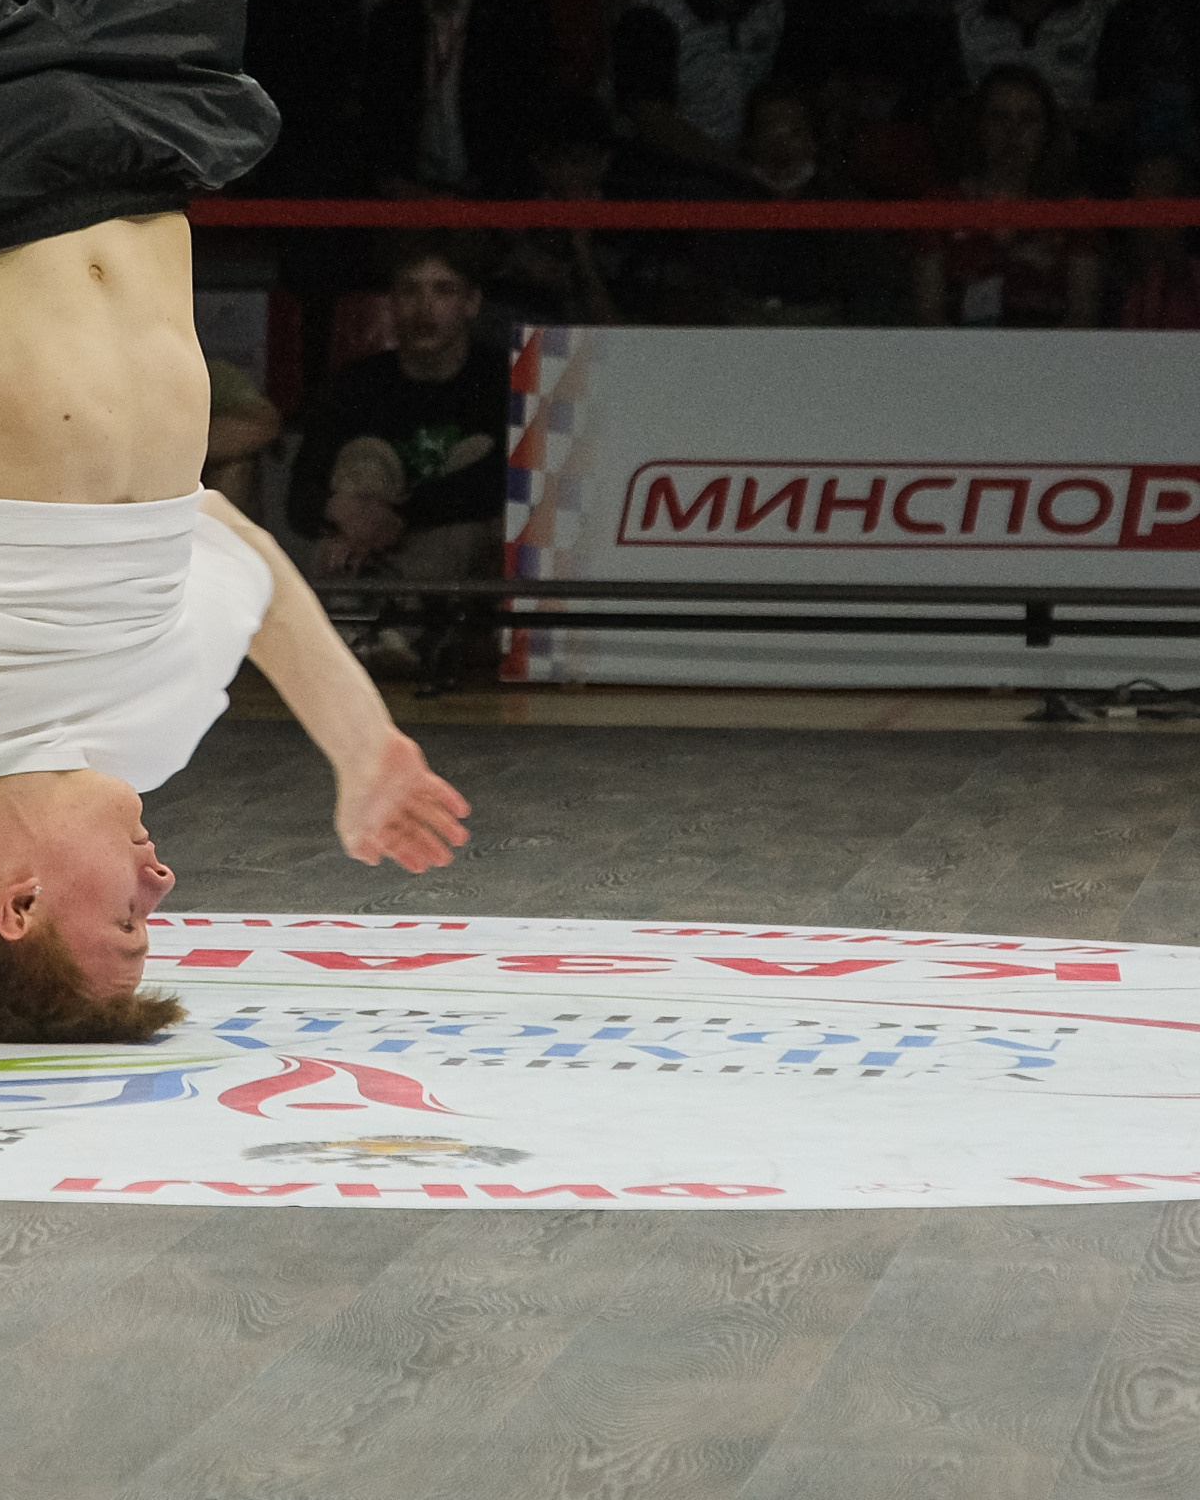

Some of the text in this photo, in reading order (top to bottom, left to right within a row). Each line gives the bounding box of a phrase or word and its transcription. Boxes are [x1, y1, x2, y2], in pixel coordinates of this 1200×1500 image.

[640, 475, 1200, 536] МИНСПОР
[632, 928, 1137, 954] ФИНАЛ
[236, 1006, 507, 1021] 2021
[50, 1176, 788, 1200] ФИНАЛ
